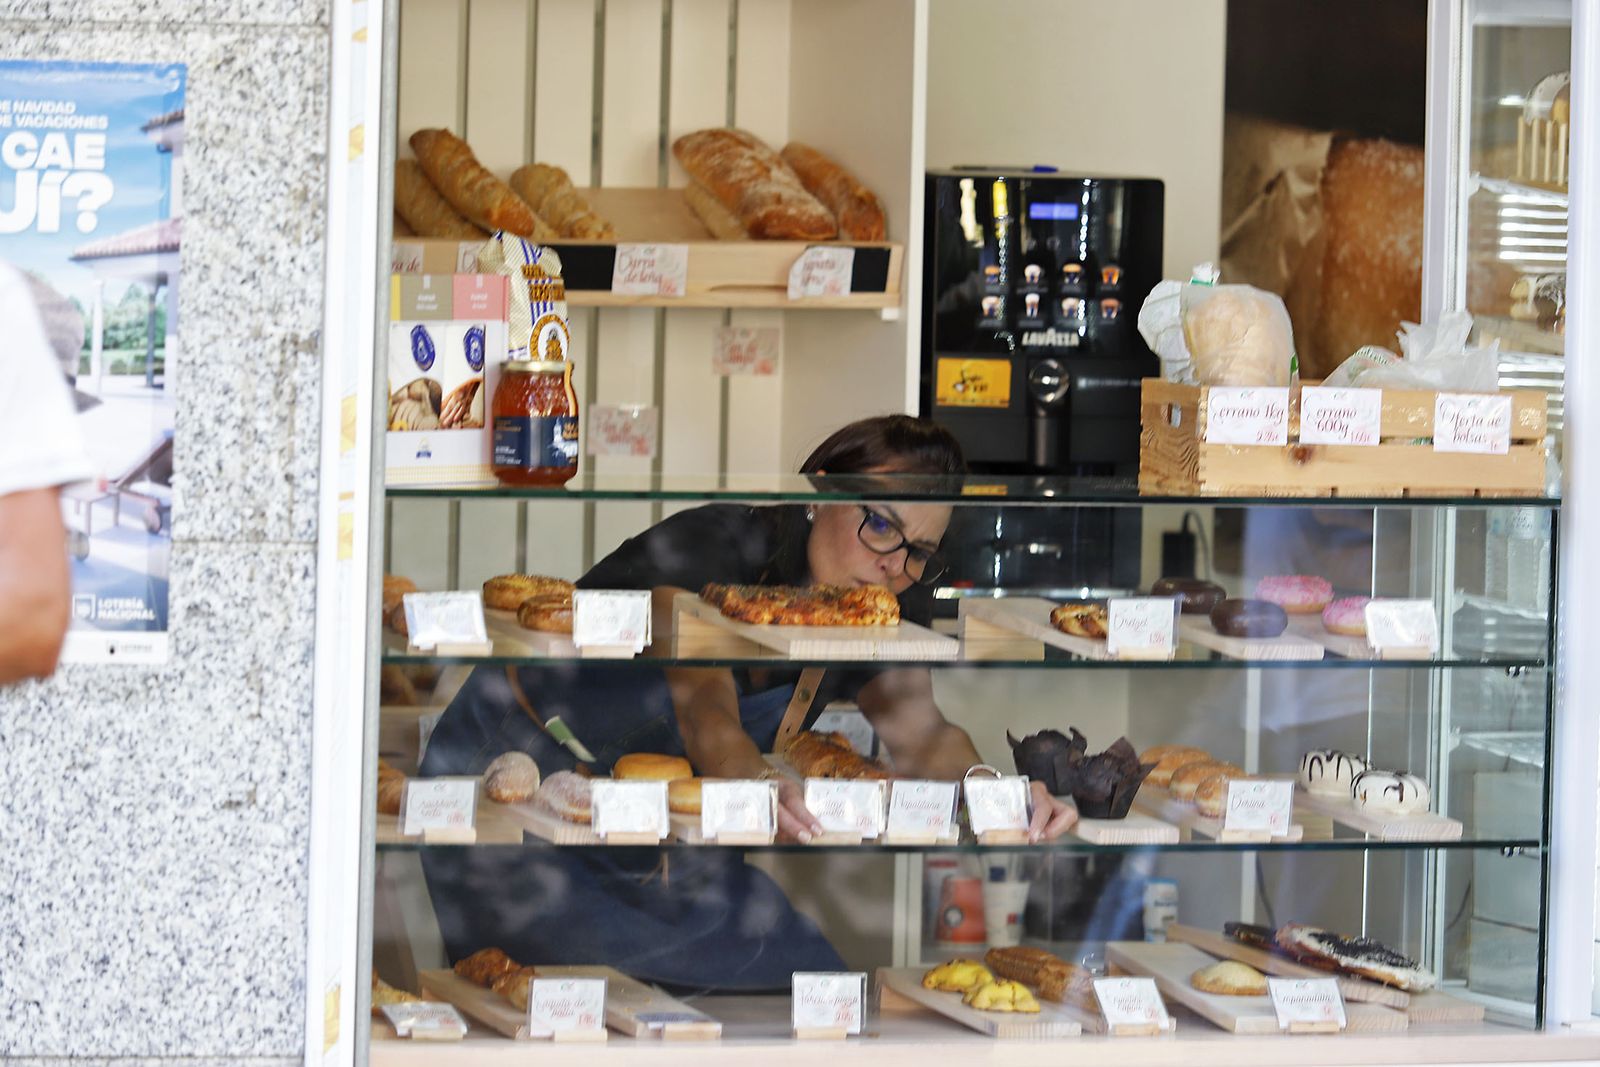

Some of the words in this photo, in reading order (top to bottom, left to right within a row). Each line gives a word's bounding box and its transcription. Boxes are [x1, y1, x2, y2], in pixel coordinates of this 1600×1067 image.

[0, 100, 11, 113] E
[13, 101, 76, 114] NAVIDAD
[15, 114, 108, 129] VACACIONES
[2, 131, 107, 170] CAE
[1022, 328, 1079, 346] LAVAZZA
[98, 608, 156, 621] NACIONAL
